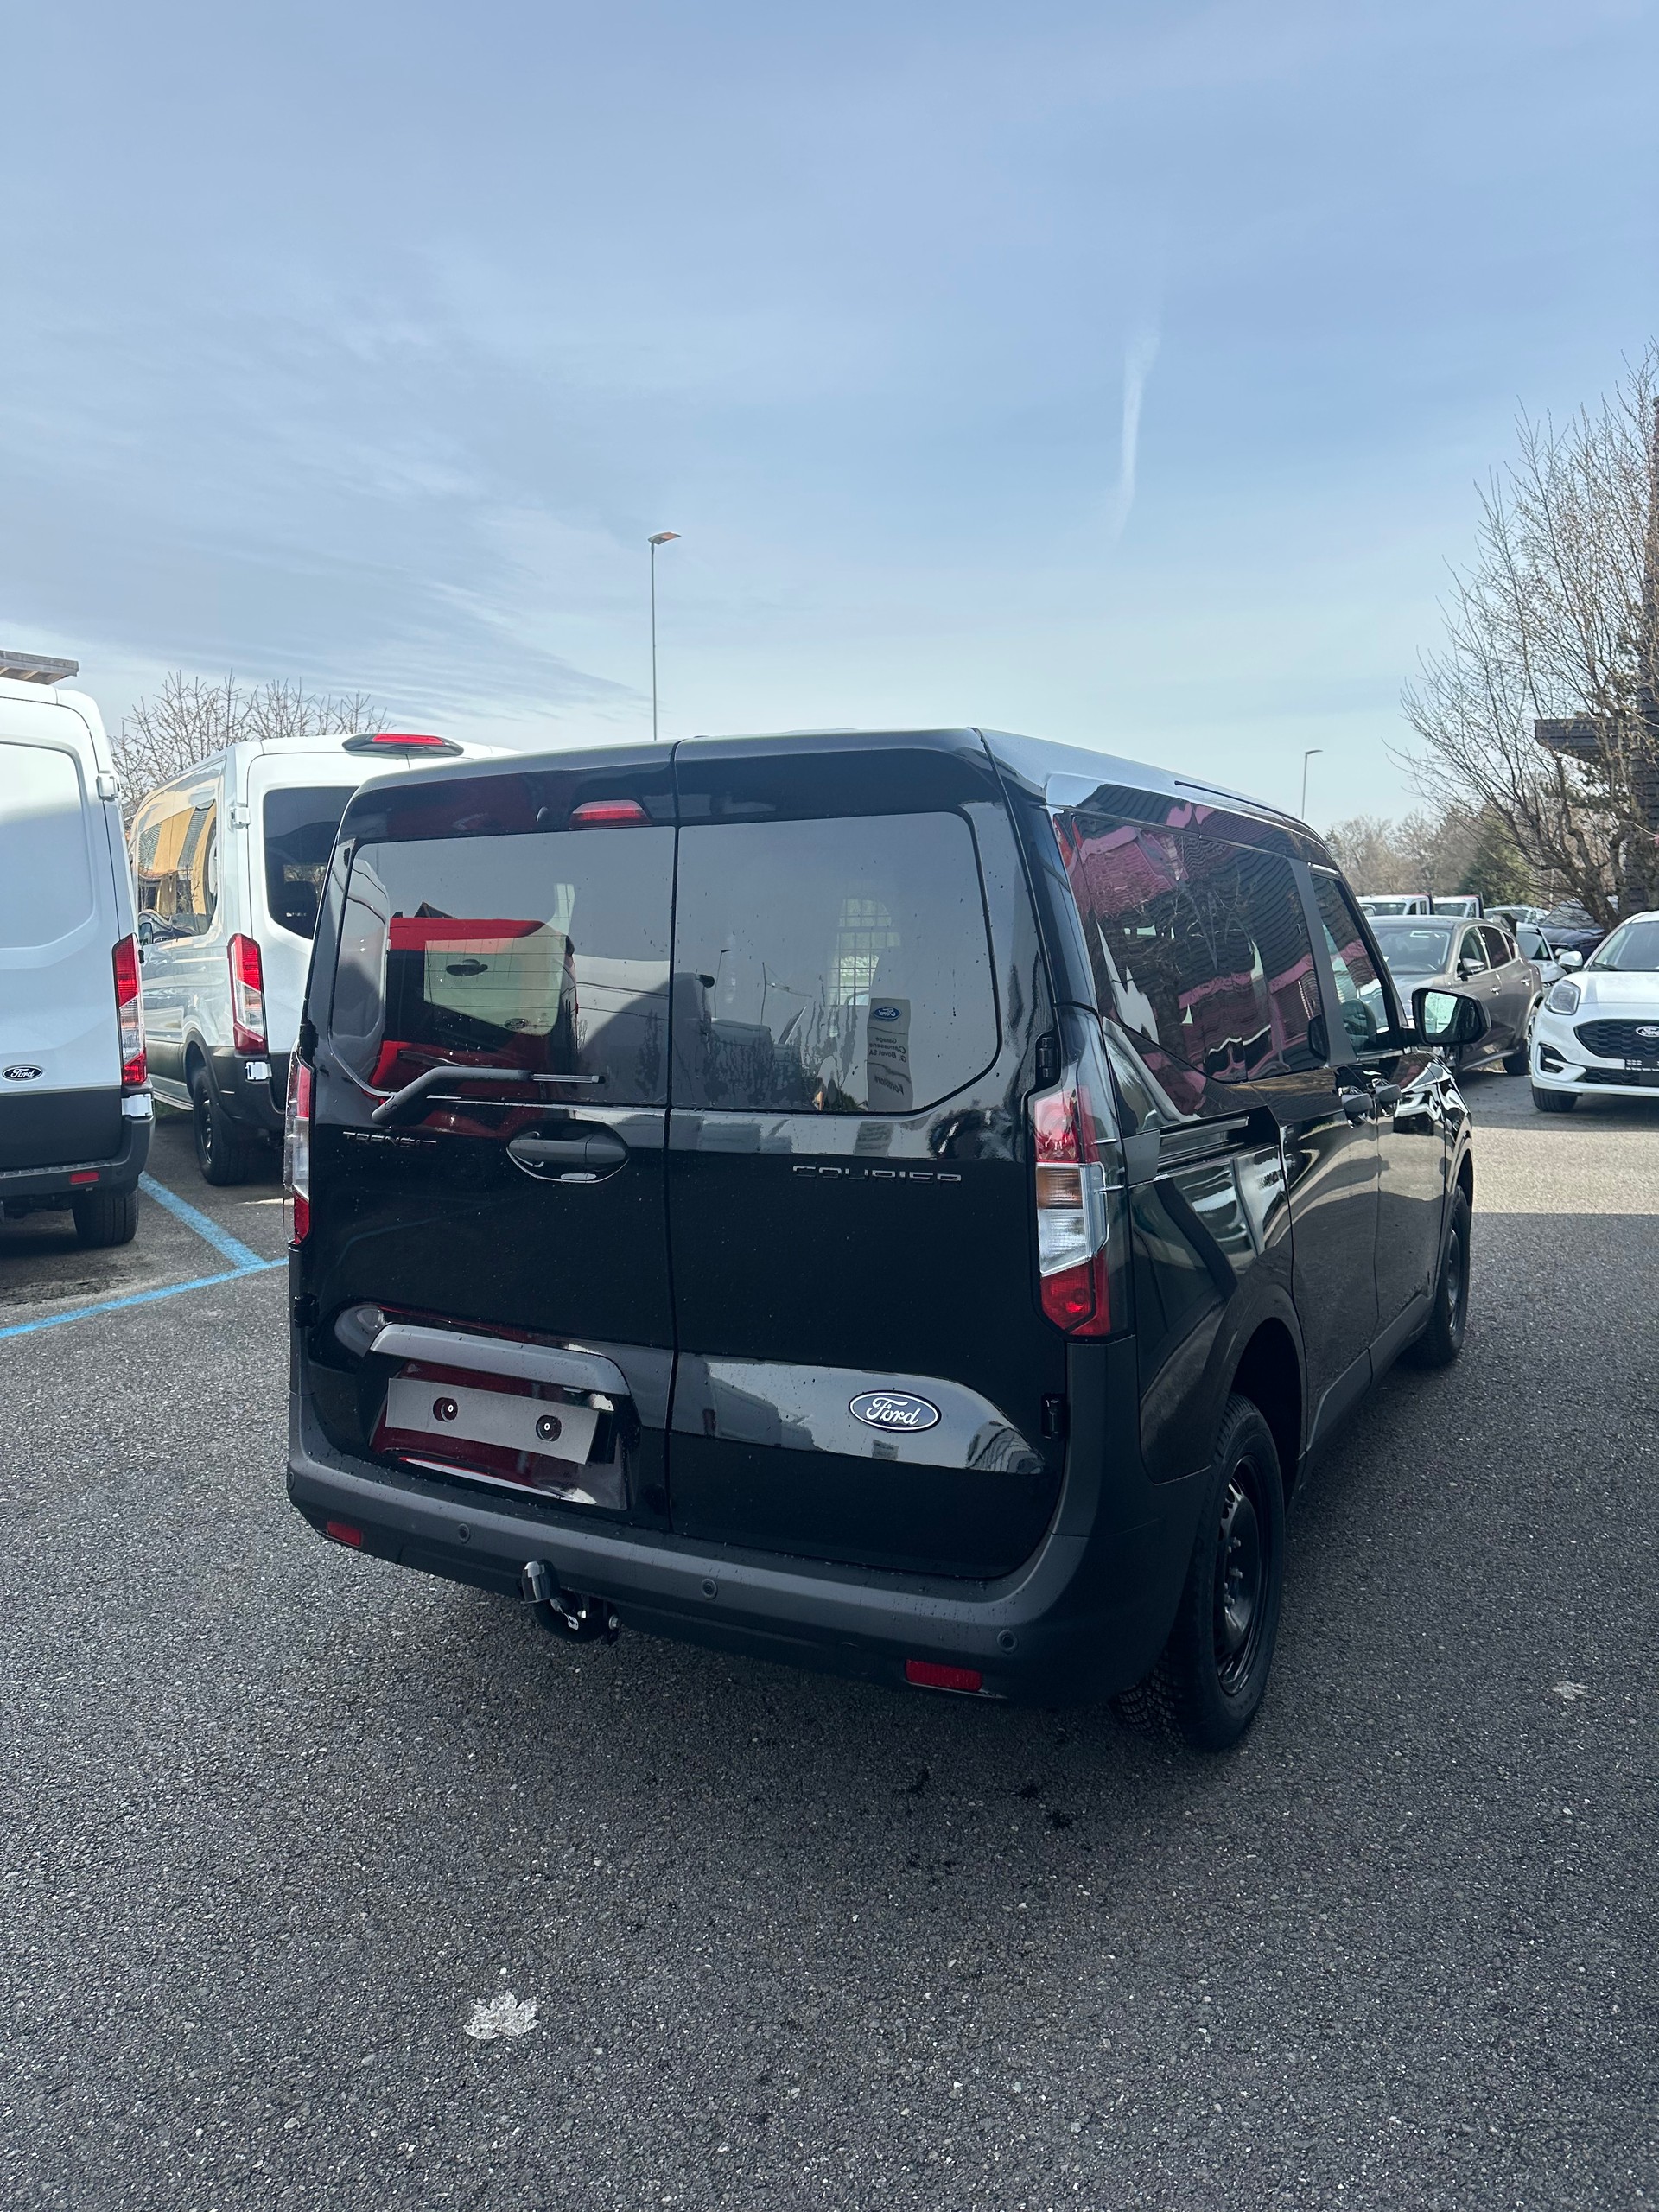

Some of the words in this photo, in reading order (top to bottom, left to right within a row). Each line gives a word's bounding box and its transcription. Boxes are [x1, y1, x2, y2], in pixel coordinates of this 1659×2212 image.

[10, 1068, 35, 1078] Ford
[342, 1130, 437, 1149] TRANSIT
[792, 1165, 962, 1187] COURIER
[866, 1397, 921, 1425] Ford
